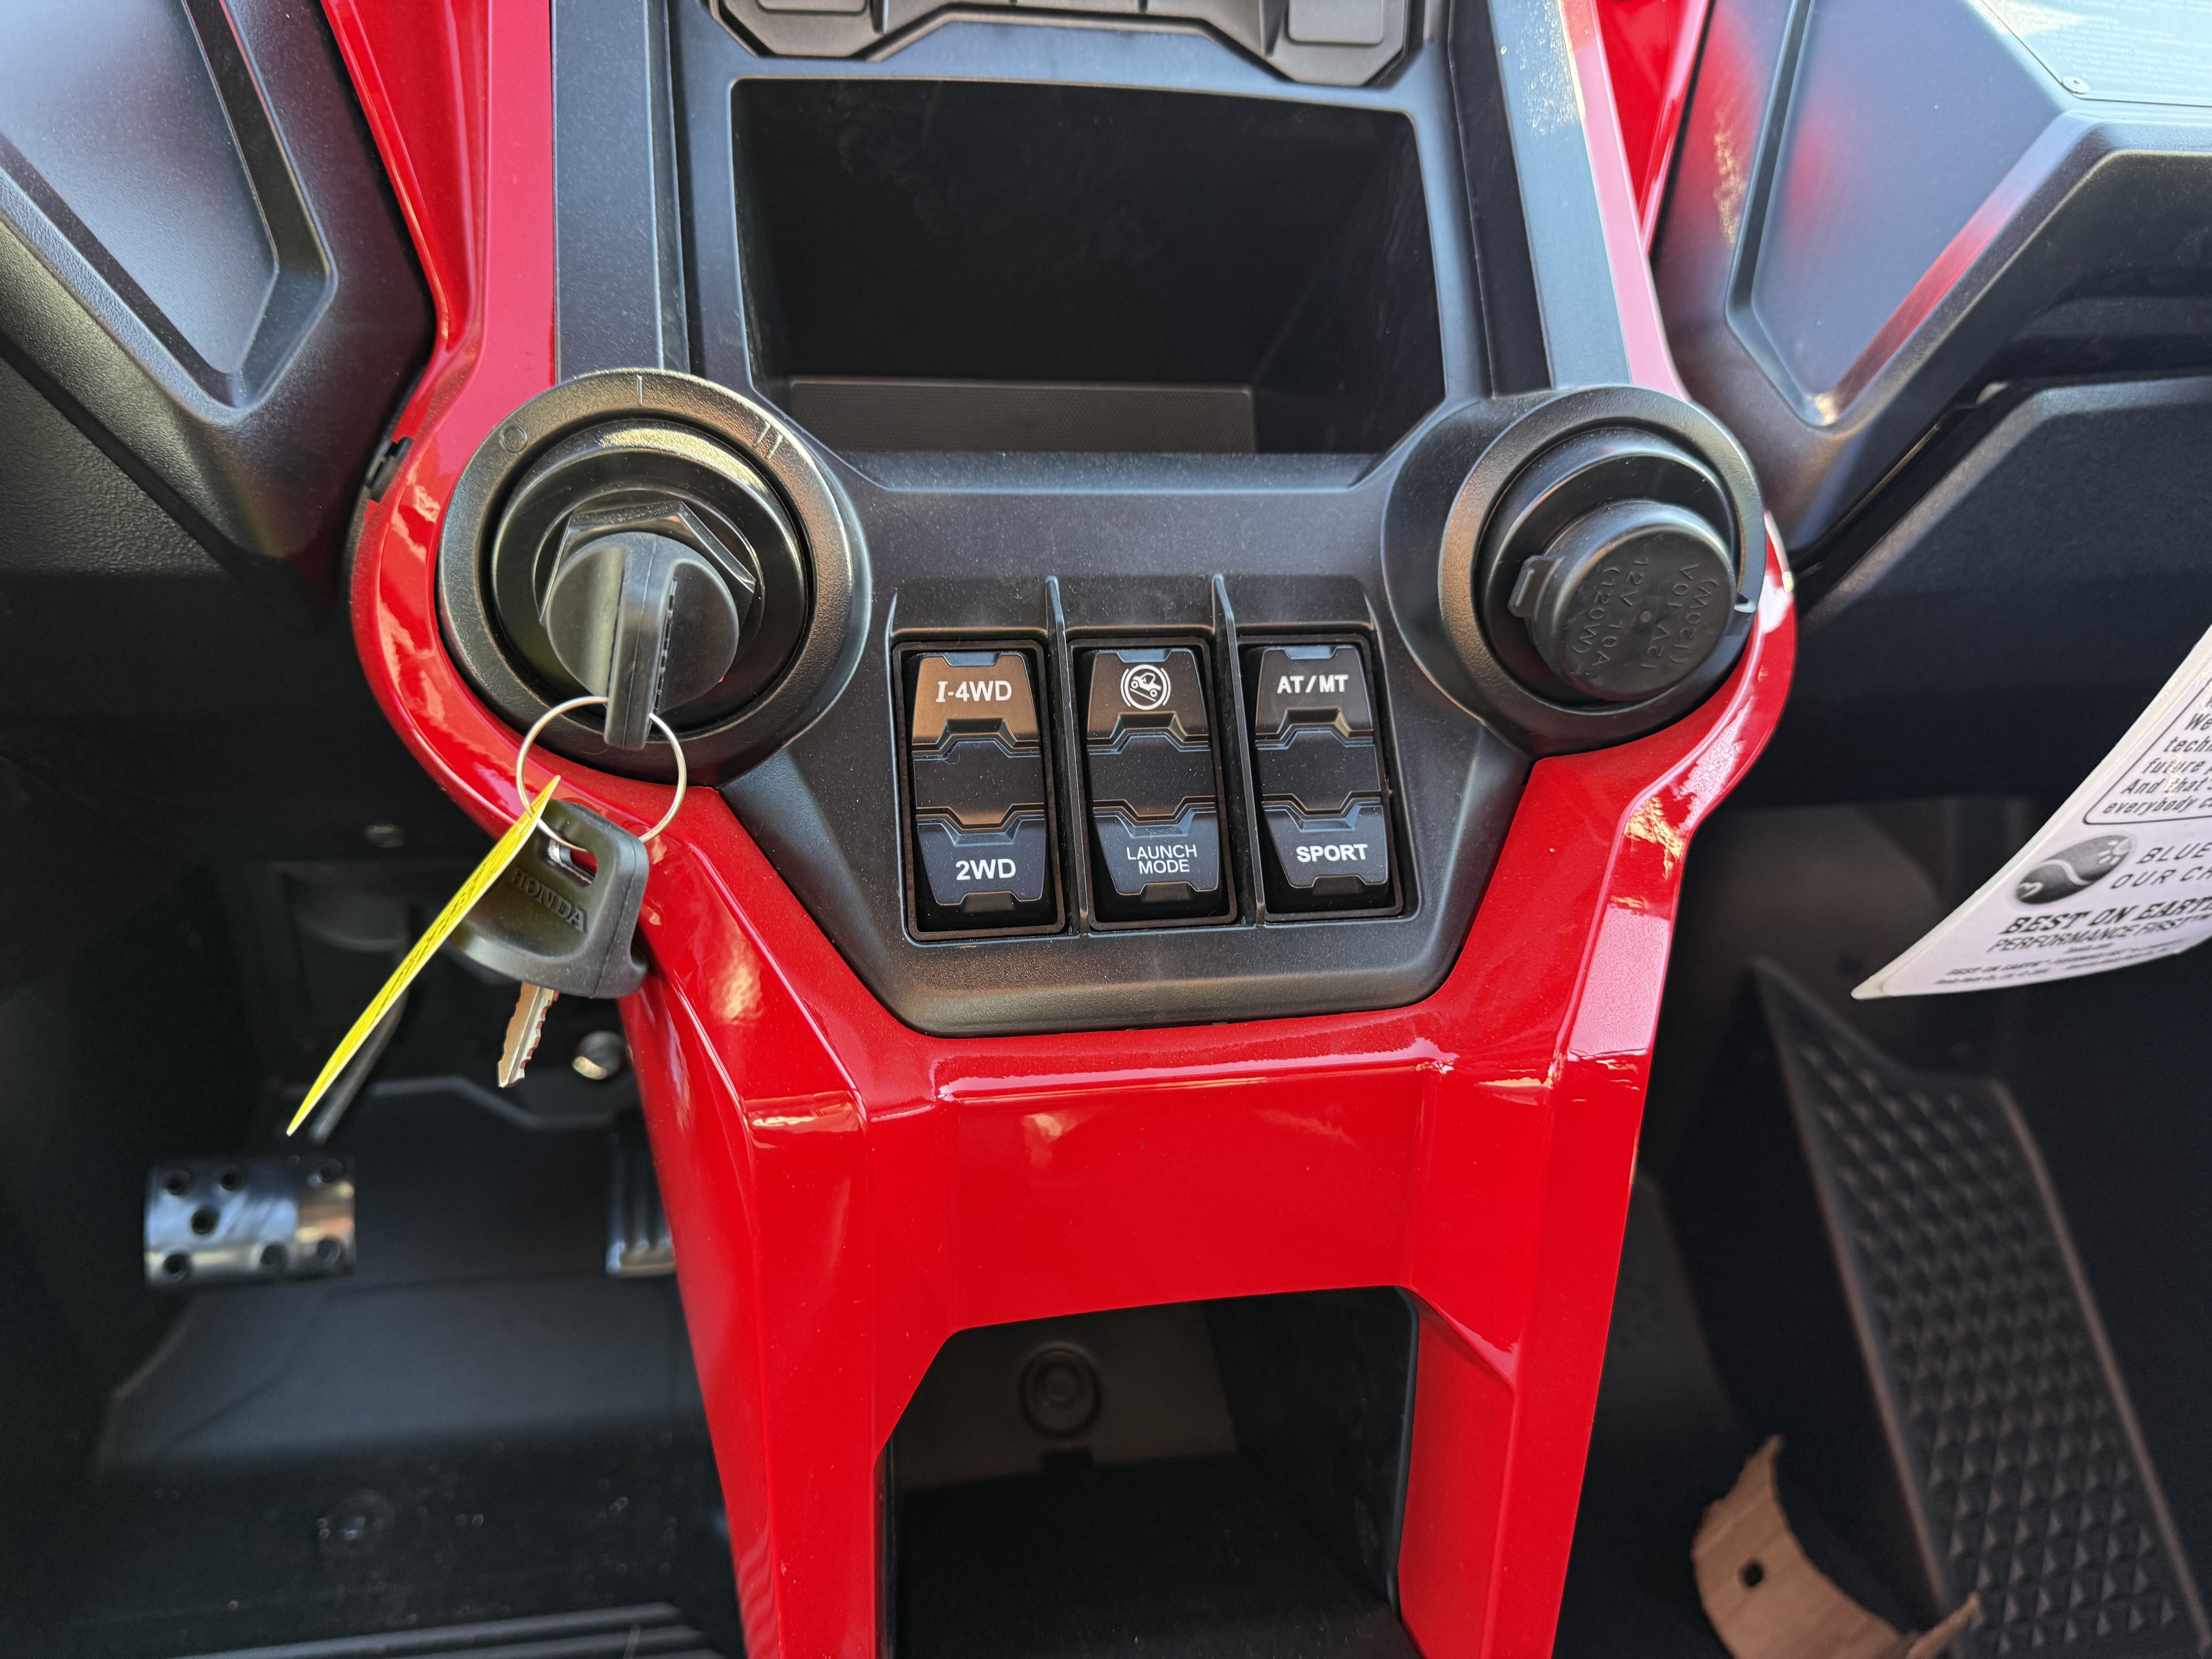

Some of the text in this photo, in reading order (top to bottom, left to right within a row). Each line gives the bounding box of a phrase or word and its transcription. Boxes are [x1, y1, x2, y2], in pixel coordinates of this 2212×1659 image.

[1571, 567, 1620, 653] (120W)
[1592, 557, 1648, 666] 12V 10A
[1640, 563, 1699, 669] 12V 10A
[1668, 579, 1719, 664] (120W)
[936, 680, 1012, 703] I-4WD
[1277, 674, 1349, 694] AT/MT
[2120, 778, 2166, 794] And
[2102, 795, 2198, 816] everybody
[1126, 844, 1198, 860] LAUNCH
[1296, 843, 1368, 863] SPORT
[2136, 842, 2212, 864] BLUE
[955, 857, 1017, 881] 2WD
[1138, 859, 1190, 875] MODE
[2110, 869, 2177, 889] OUR
[510, 867, 589, 934] HONDA
[1998, 910, 2092, 935] BEST
[2087, 905, 2139, 926] ON
[1985, 924, 2141, 953] PERFORMANCE
